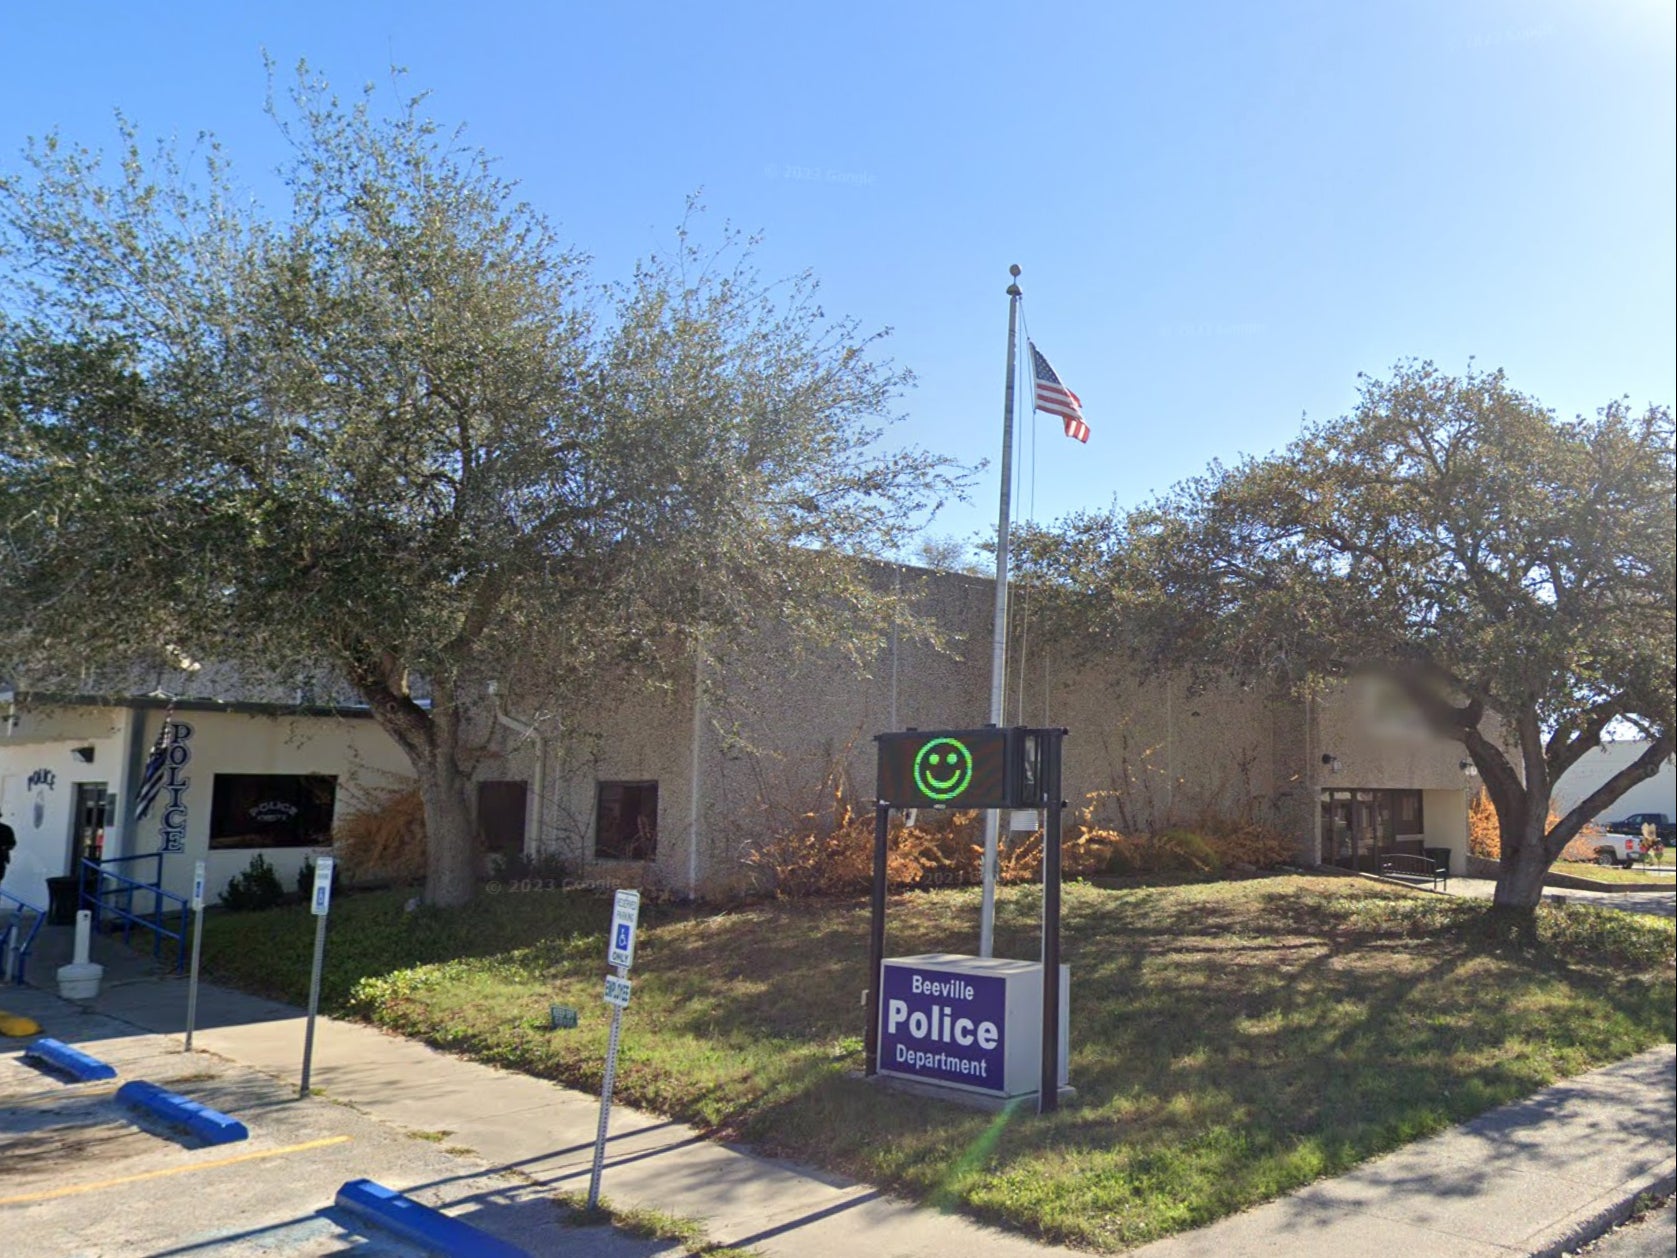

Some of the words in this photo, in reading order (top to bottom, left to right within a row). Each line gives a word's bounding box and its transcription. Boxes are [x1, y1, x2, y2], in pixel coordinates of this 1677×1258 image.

[27, 768, 56, 792] POLICE
[162, 722, 194, 852] POLICE
[612, 951, 629, 963] ONLY
[912, 975, 974, 1000] Beeville
[887, 999, 998, 1050] Police
[896, 1044, 987, 1078] Department
